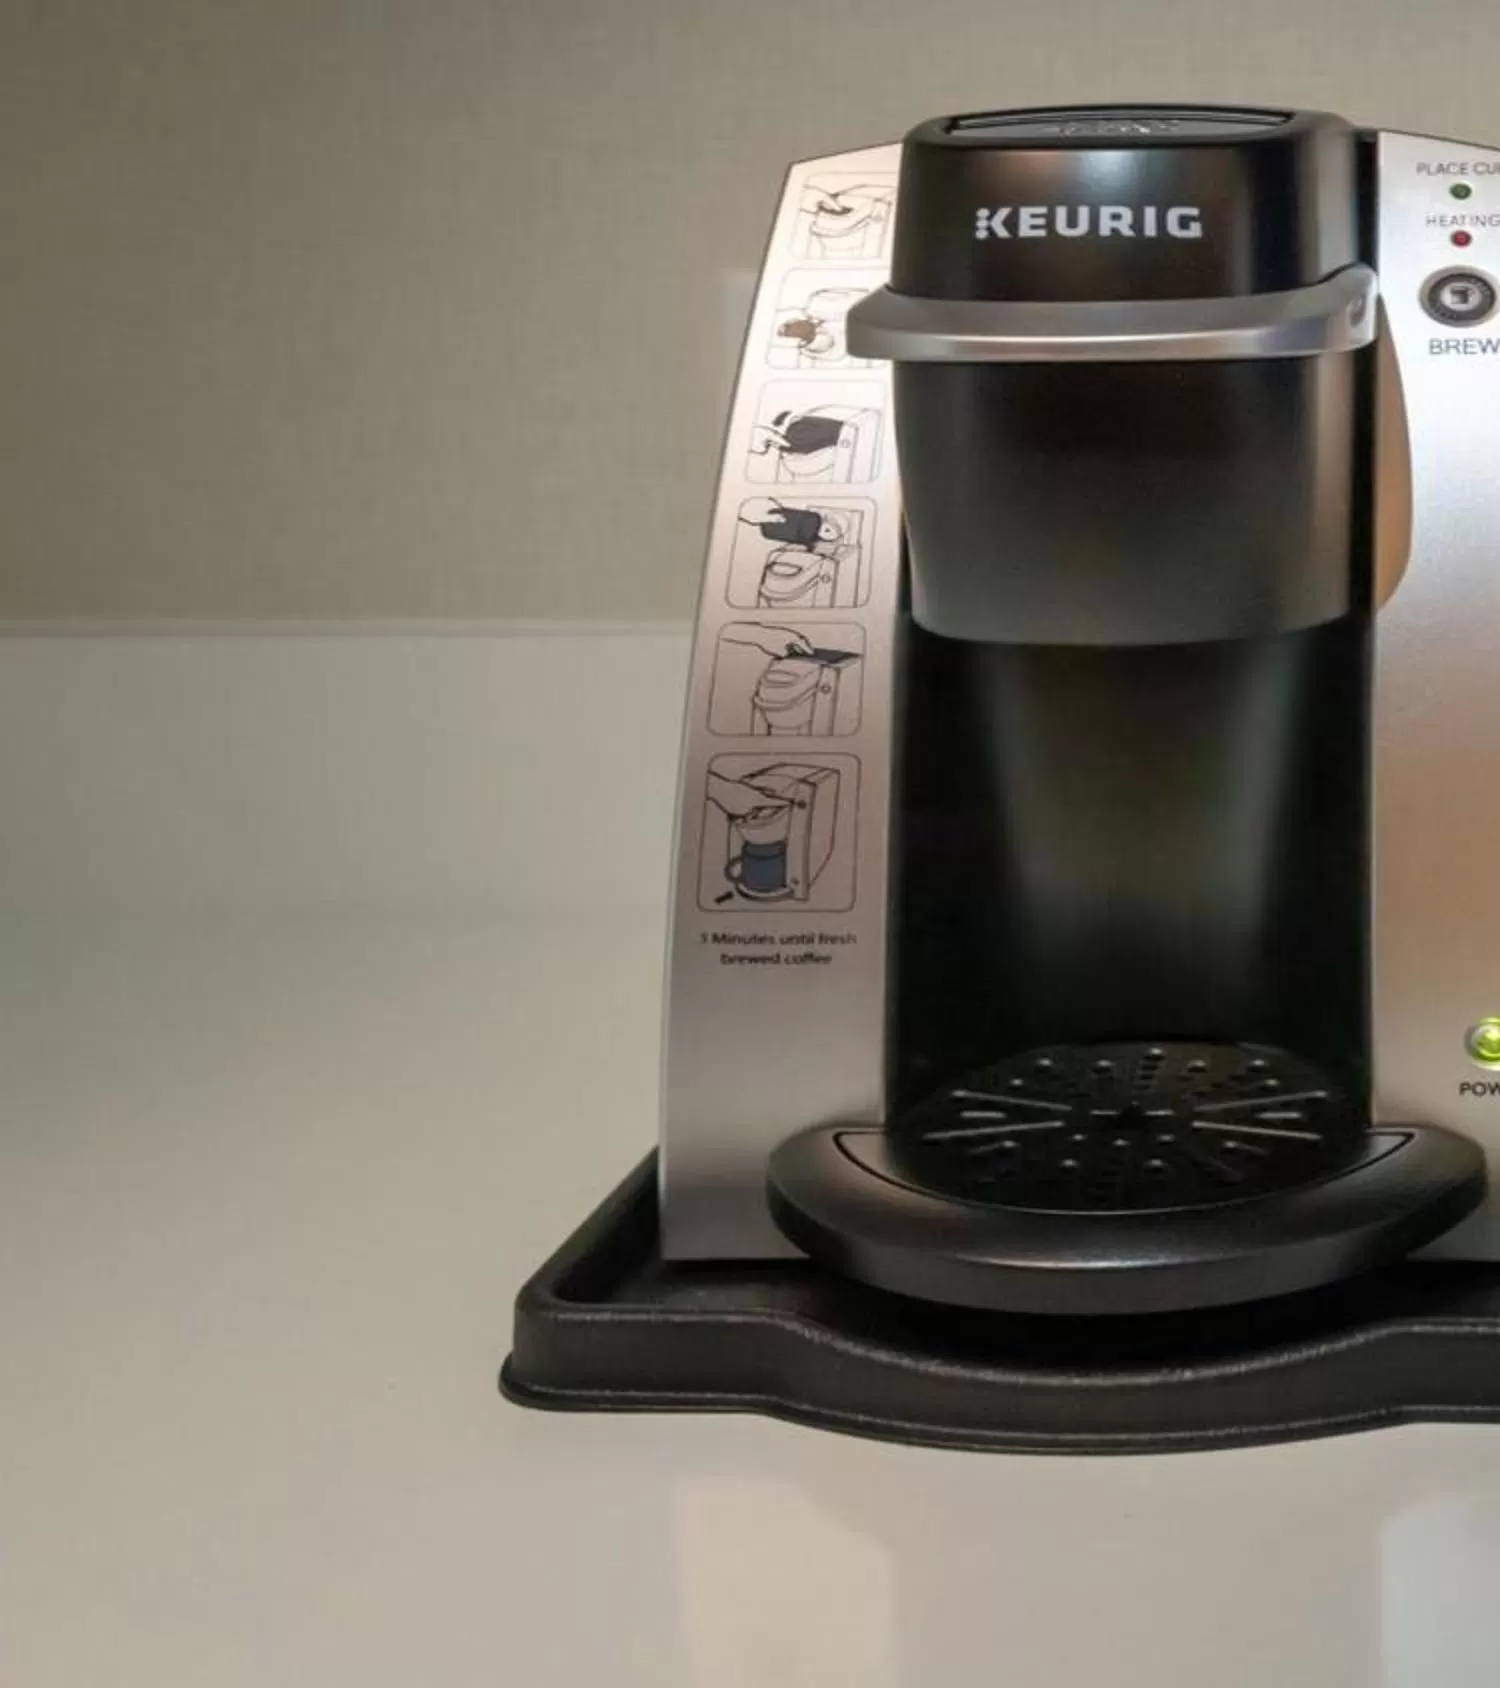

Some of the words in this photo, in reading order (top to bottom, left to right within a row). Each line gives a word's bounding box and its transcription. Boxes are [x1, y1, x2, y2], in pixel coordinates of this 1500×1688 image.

[1415, 161, 1469, 176] PLACE
[975, 205, 1203, 240] KEURIG
[711, 931, 775, 945] Minutes
[778, 931, 815, 945] until
[818, 931, 858, 945] fresh
